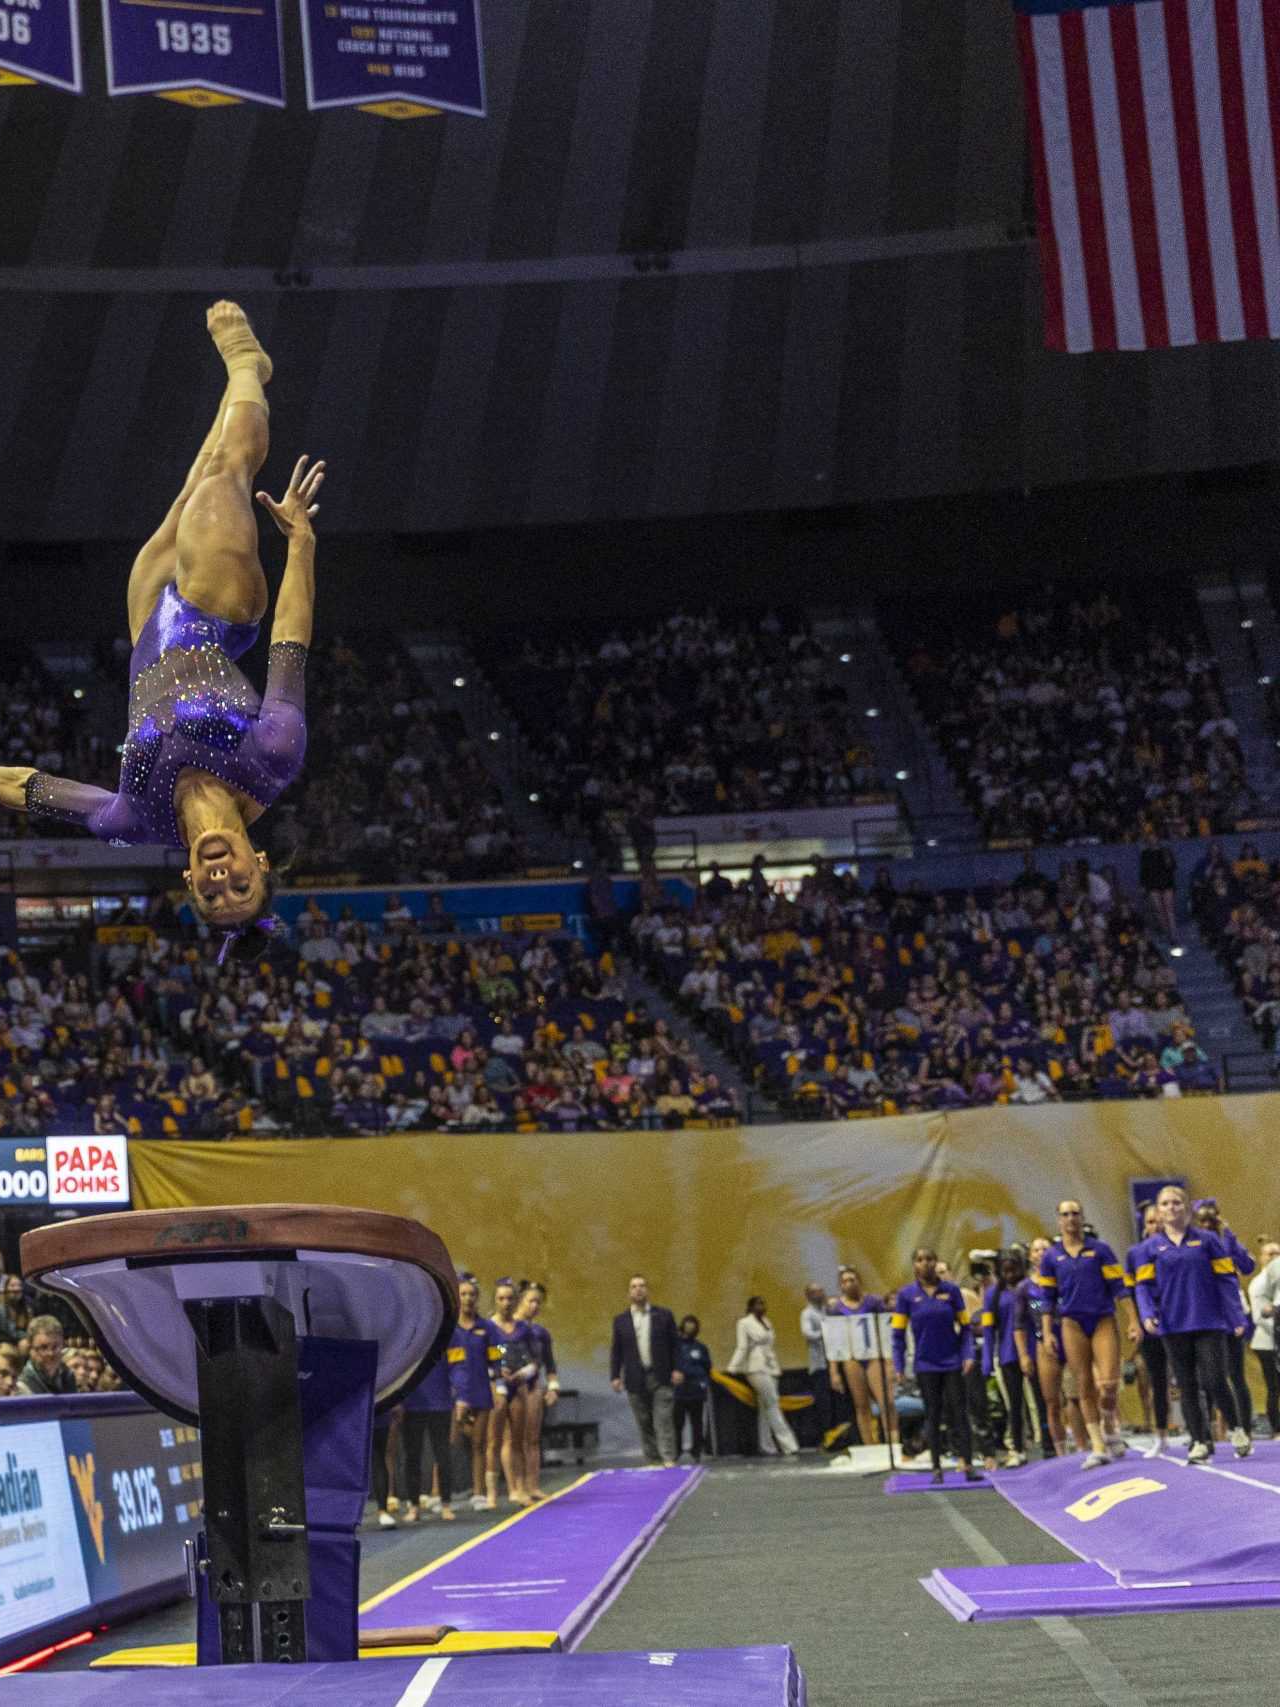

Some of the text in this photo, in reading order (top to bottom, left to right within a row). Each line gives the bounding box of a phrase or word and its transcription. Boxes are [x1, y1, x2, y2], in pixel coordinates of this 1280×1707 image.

[156, 19, 232, 56] 1935
[55, 1146, 118, 1171] PAPA
[55, 1176, 120, 1194] JOHNS
[112, 1465, 163, 1533] 39.125
